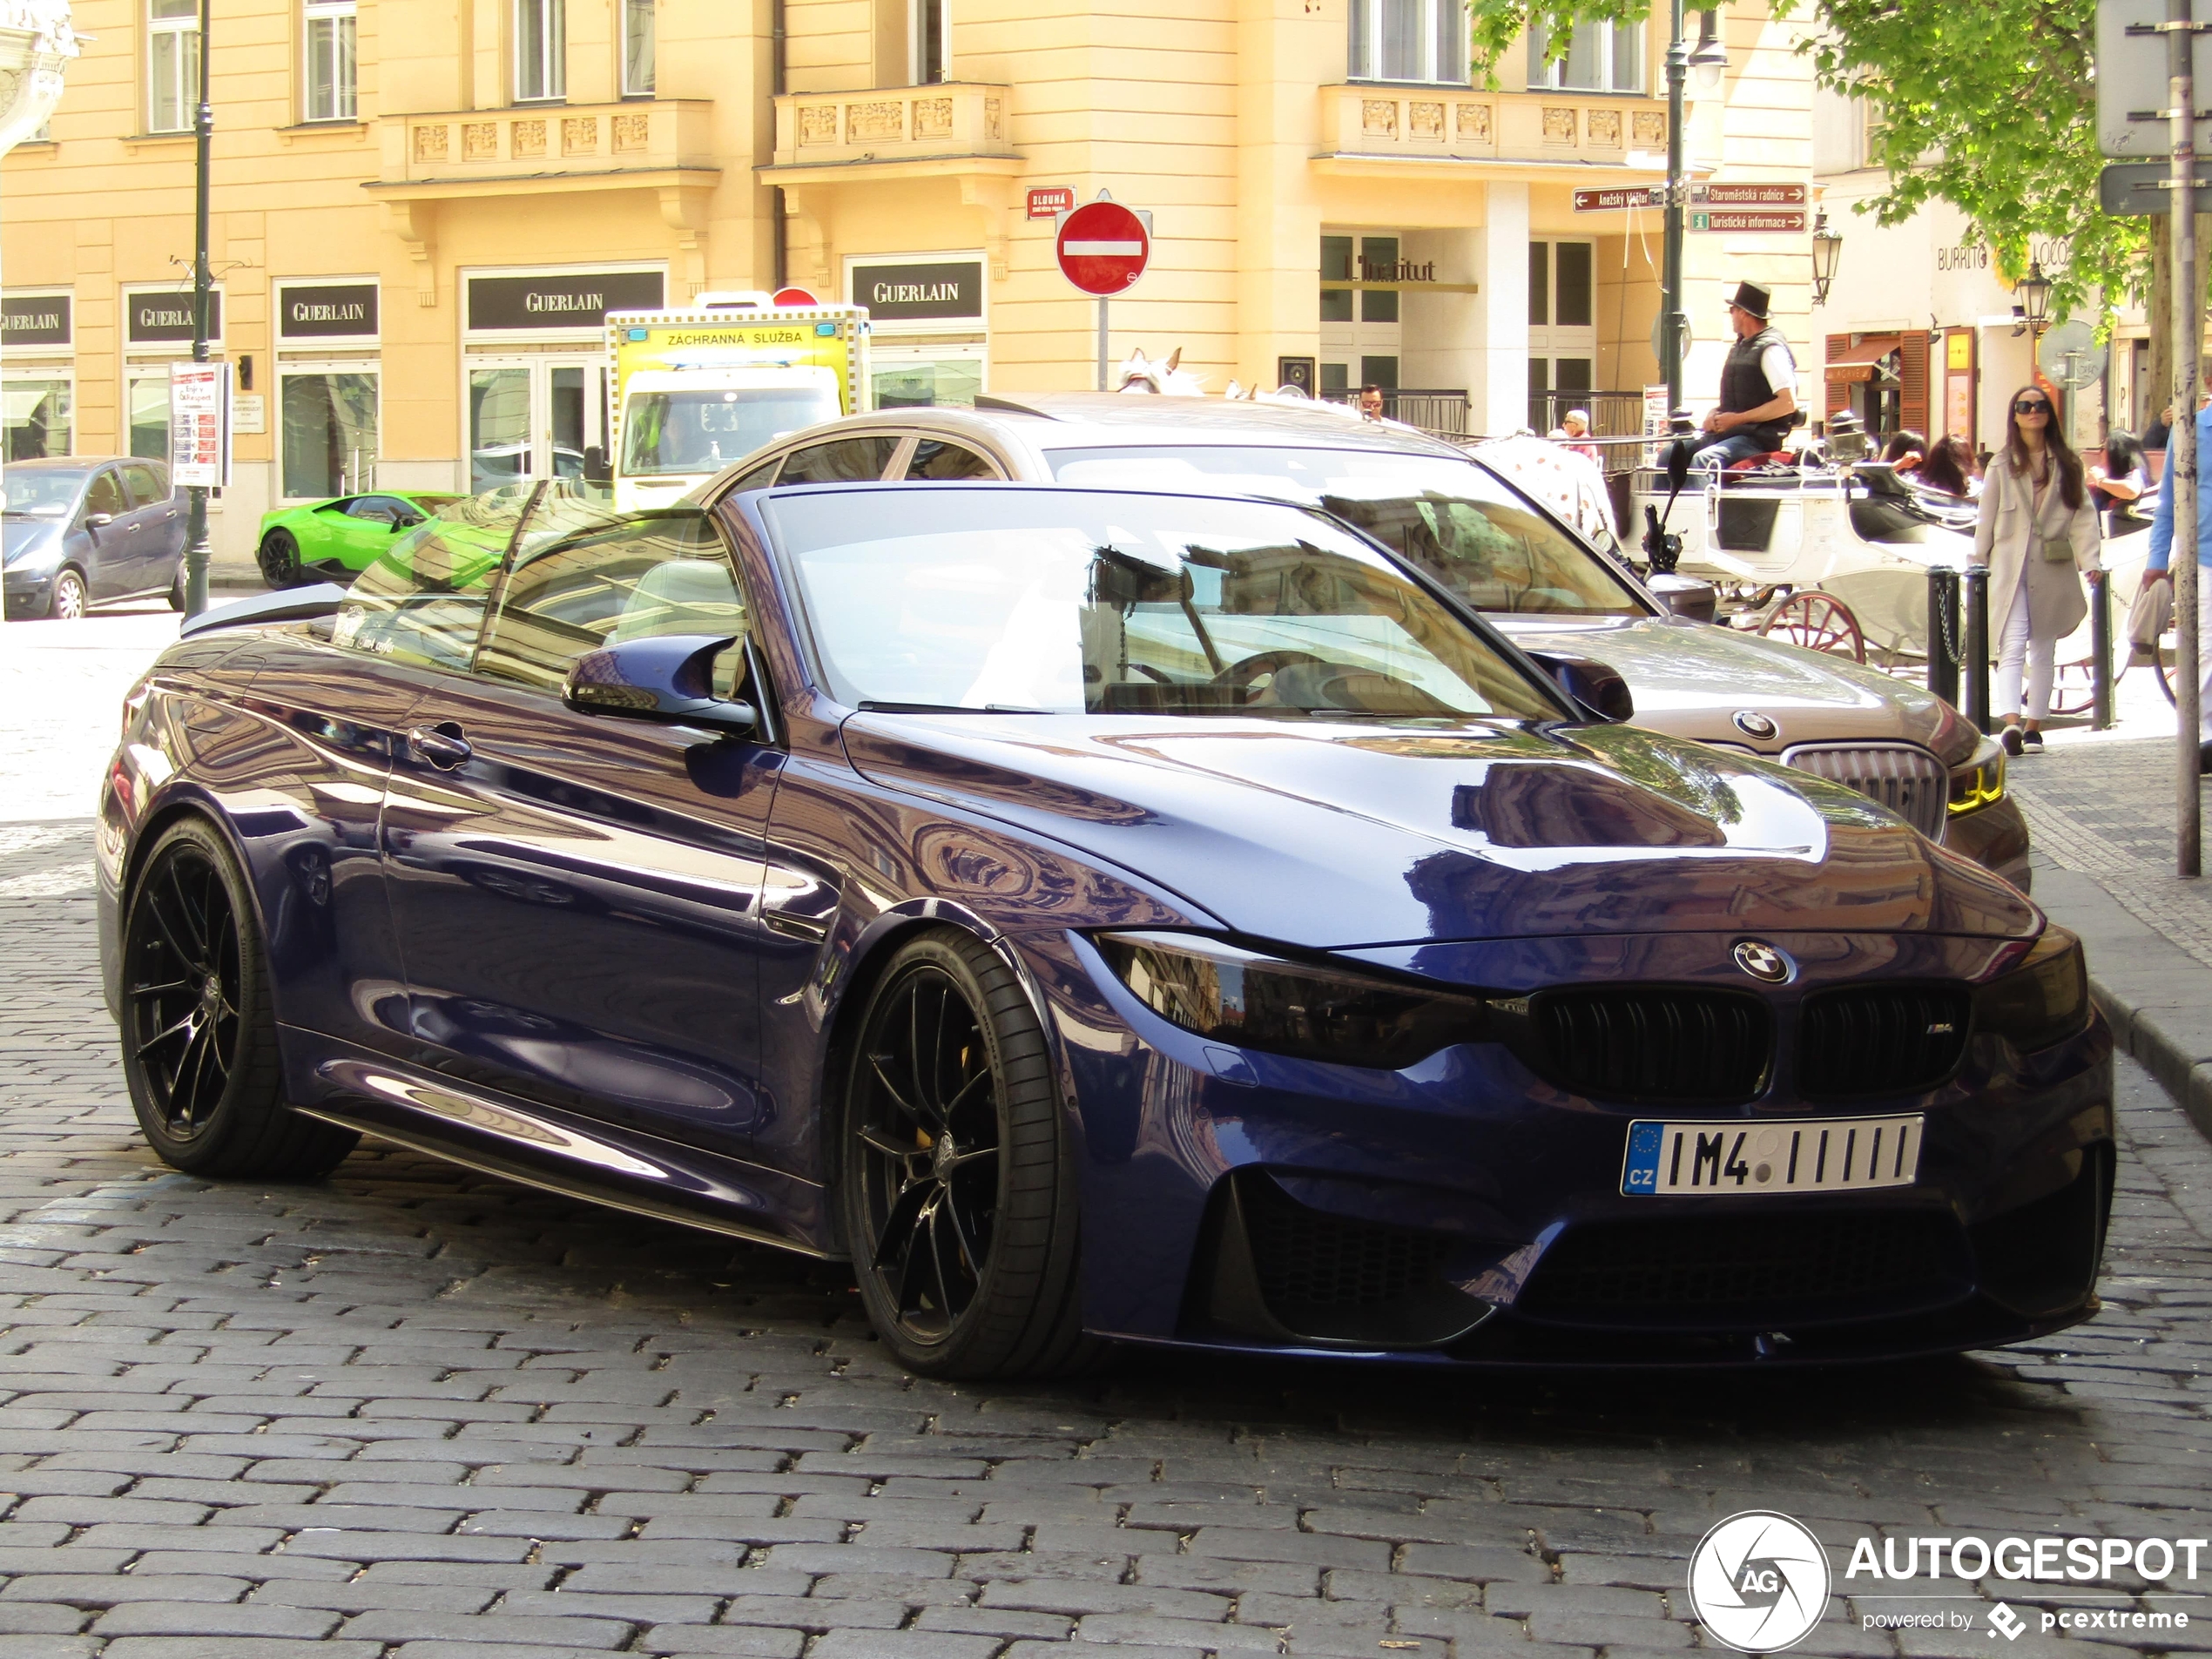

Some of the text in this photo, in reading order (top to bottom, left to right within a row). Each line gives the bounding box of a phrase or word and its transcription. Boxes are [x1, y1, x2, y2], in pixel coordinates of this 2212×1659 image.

[1033, 192, 1066, 206] DLOUHÁ
[1598, 193, 1625, 208] Anežský
[1710, 188, 1784, 201] Staroměstská radnice
[1710, 215, 1787, 228] Turistické informace
[1938, 246, 1987, 271] BURRITO
[873, 282, 959, 304] GUERLAIN
[526, 293, 604, 313] GUERLAIN
[141, 308, 194, 327] GUERLA
[293, 302, 364, 322] GUERLAIN
[668, 331, 803, 346] ZÁCHRANNÁ SLUŽBA
[1629, 1169, 1654, 1185] CZ
